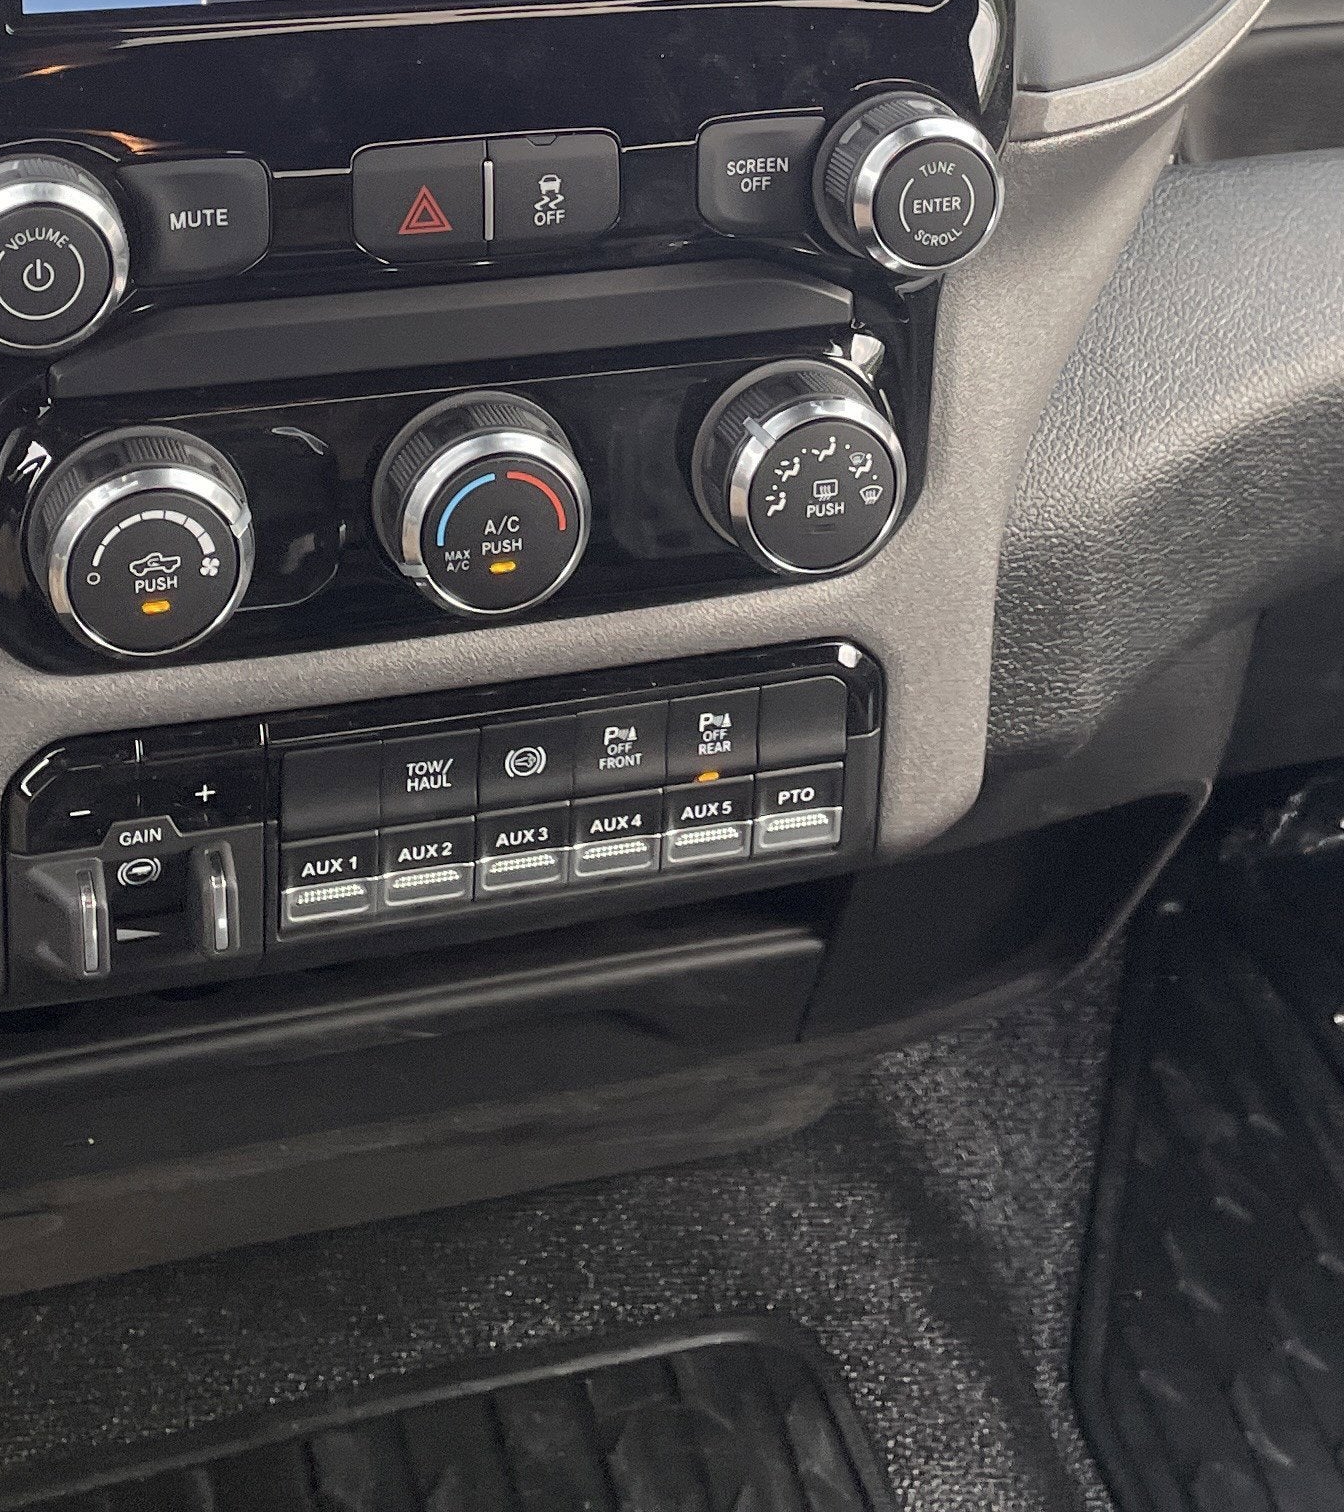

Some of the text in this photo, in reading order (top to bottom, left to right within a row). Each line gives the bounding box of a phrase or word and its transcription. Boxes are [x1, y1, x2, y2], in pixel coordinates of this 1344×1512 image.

[726, 157, 789, 177] SCREEN
[918, 160, 957, 178] TUNE
[740, 176, 772, 194] OFF
[912, 196, 963, 216] ENTER
[169, 208, 229, 231] MUTE
[533, 208, 566, 227] OFF
[5, 226, 70, 254] VOLUME
[914, 226, 963, 247] SCROLL
[806, 501, 845, 519] PUSH
[484, 515, 521, 537] A/C
[444, 548, 472, 562] MAX
[481, 538, 523, 557] PUSH
[445, 559, 471, 573] A/C
[134, 574, 179, 594] PUSH
[702, 728, 729, 742] OFF
[607, 741, 634, 756] OFF
[698, 741, 732, 756] REAR
[406, 758, 454, 778] TOW/
[598, 752, 644, 771] FRONT
[406, 774, 452, 792] HAUL
[777, 787, 816, 806] PTO
[680, 800, 733, 821] AUX 5
[589, 813, 643, 835] AUX 4
[118, 827, 163, 847] GAIN
[495, 826, 549, 848] AUX 3
[397, 842, 453, 863] AUX 2
[301, 855, 358, 878] AUX 1
